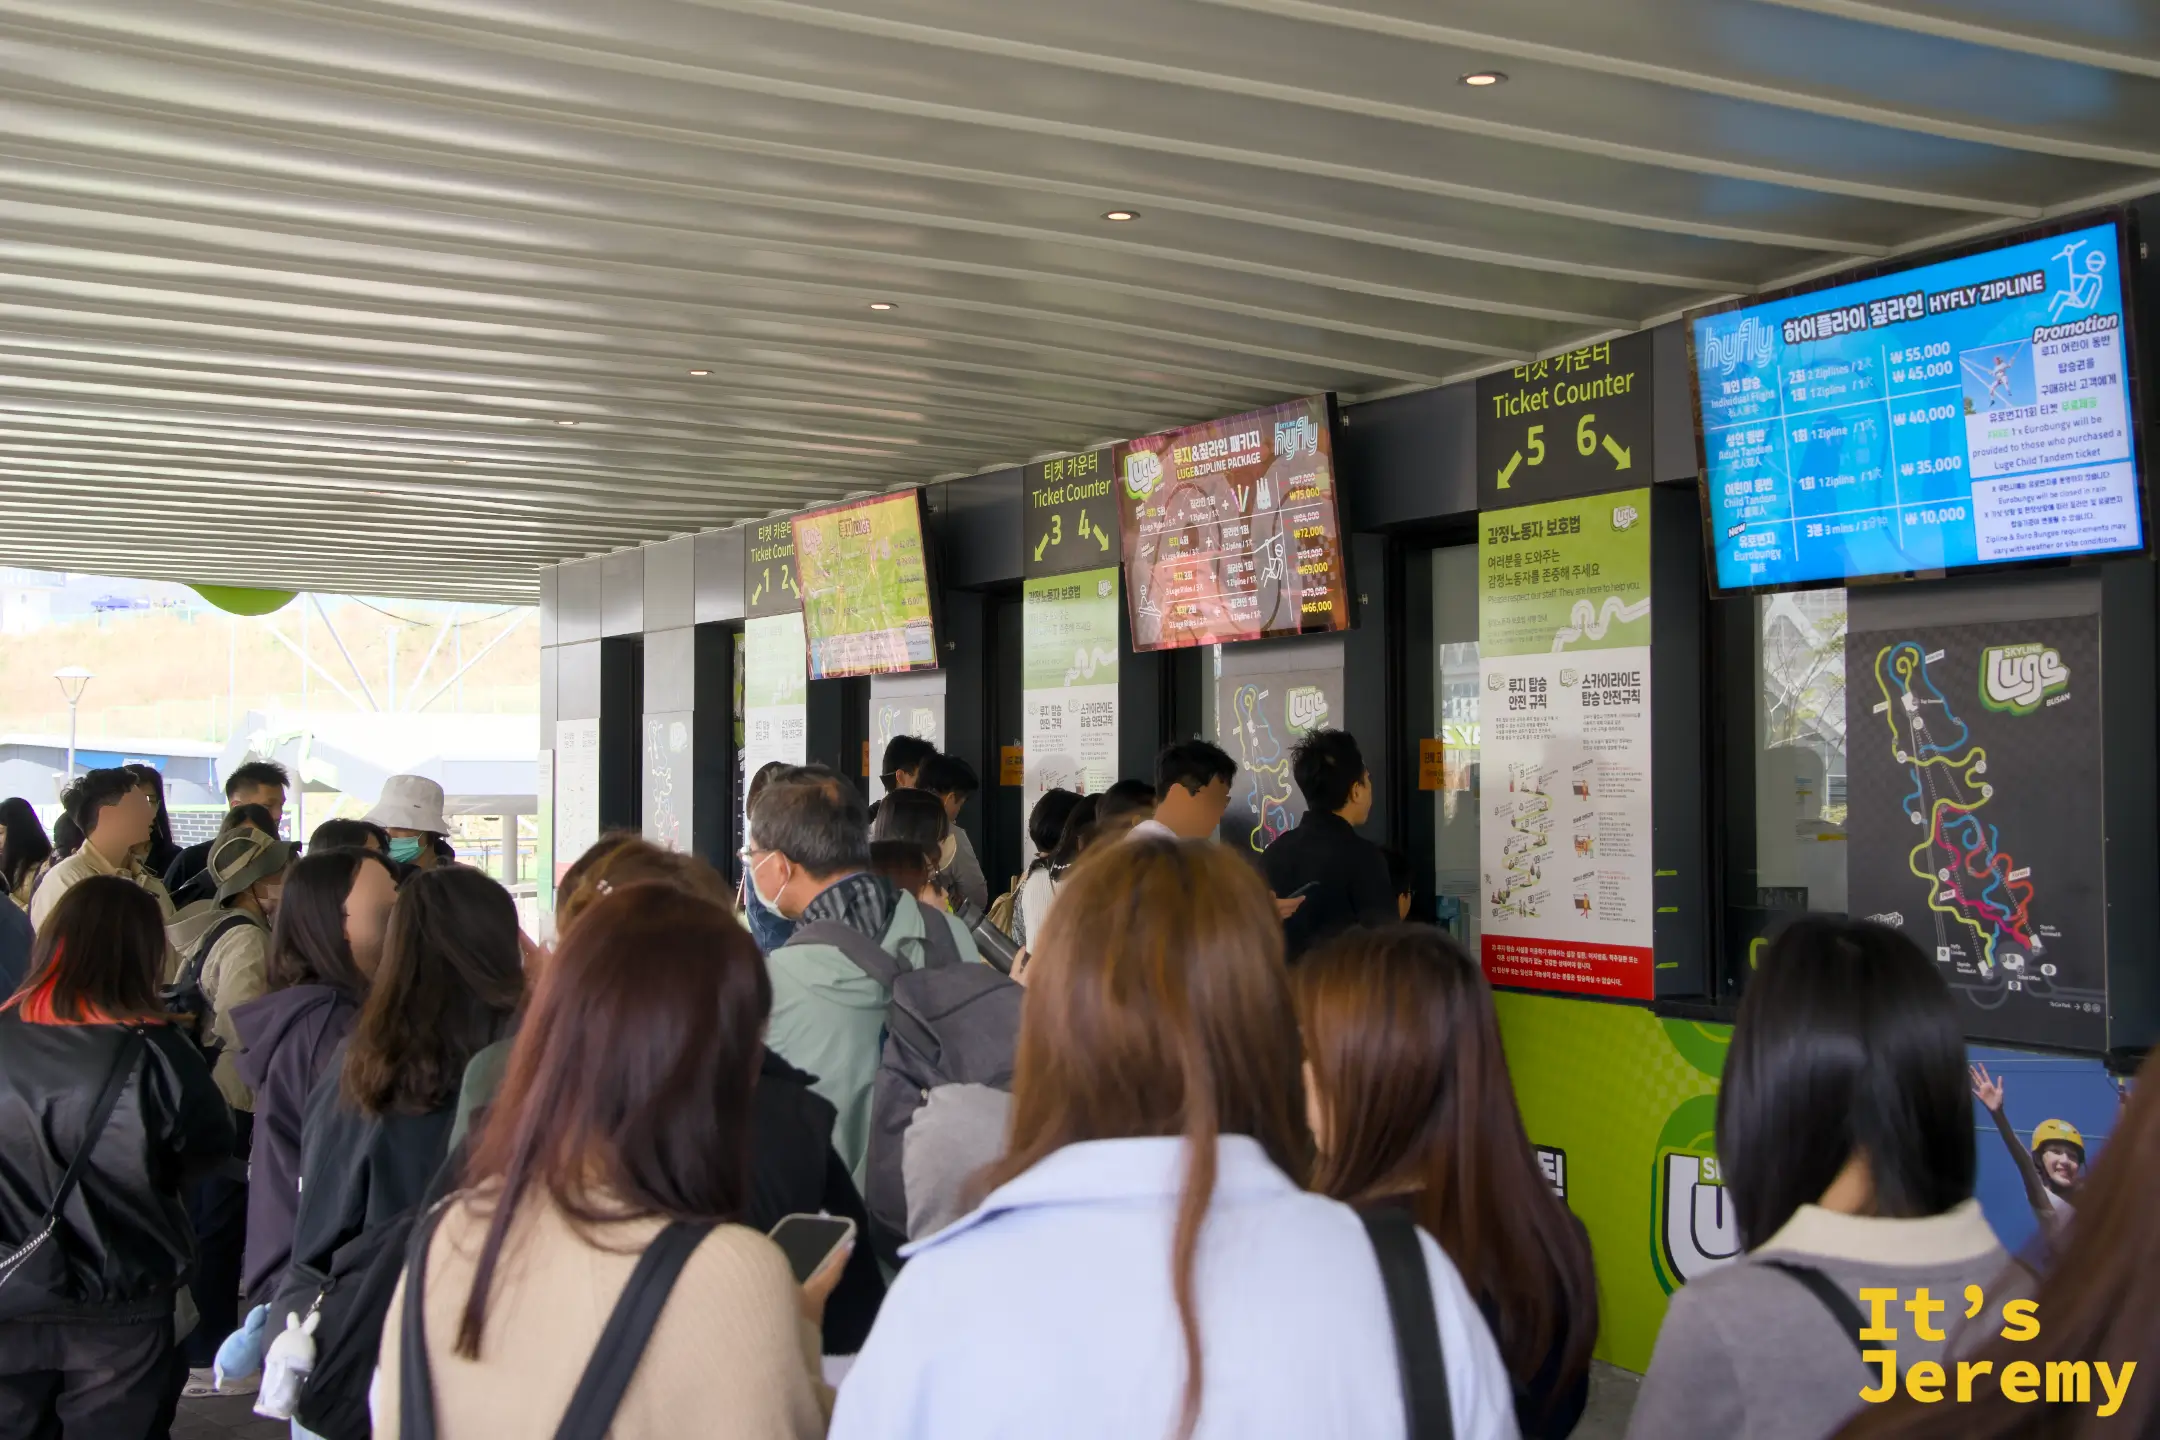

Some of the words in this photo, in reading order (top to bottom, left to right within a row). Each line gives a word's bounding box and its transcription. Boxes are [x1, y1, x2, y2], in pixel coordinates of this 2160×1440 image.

[1782, 305, 1867, 343] 하이플라이
[1928, 287, 1978, 313] HYFLY
[1979, 272, 2044, 302] ZIPLINE
[2032, 313, 2119, 344] Promotion
[1703, 316, 1774, 376] hyfly
[1904, 341, 1951, 363] 55,000
[2061, 339, 2090, 354] 어린이
[2092, 335, 2111, 349] 동반
[1815, 364, 1849, 381] Ziplines
[1907, 360, 1953, 382] 45,000
[2057, 357, 2096, 375] 탑승권을
[1816, 384, 1847, 400] Zipline
[2041, 380, 2077, 397] 구매하신
[2079, 373, 2117, 390] 고객에게
[1493, 387, 1549, 419] Ticket
[1553, 372, 1635, 407] Counter
[1908, 404, 1956, 424] 40,000
[1817, 426, 1848, 441] Zipline
[2024, 419, 2071, 435] Eurobungy
[2073, 415, 2089, 426] will
[2090, 414, 2102, 425] be
[1229, 430, 1261, 452] 패키지
[1274, 415, 1318, 461] hyfly
[1527, 424, 1545, 466] 5
[1576, 413, 1597, 456] 6
[1972, 444, 2009, 459] provided
[2010, 443, 2019, 452] to
[2021, 438, 2045, 451] those
[2047, 436, 2066, 447] who
[2067, 430, 2114, 447] purchased
[1718, 448, 1741, 460] Adult
[1741, 444, 1773, 458] Tandem
[1994, 458, 2015, 472] Luge
[2016, 455, 2037, 467] Child
[2038, 450, 2074, 465] Tandem
[2075, 447, 2101, 460] ticket
[1043, 458, 1064, 482] 티켓
[1067, 450, 1098, 477] 카운터
[1126, 452, 1162, 494] Luge
[1176, 459, 1227, 481] LUGE&ZIPLINE
[1227, 451, 1262, 470] PACKAGE
[1916, 455, 1962, 475] 35,000
[1825, 474, 1856, 489] Zipline
[1032, 486, 1065, 508] Ticket
[1066, 479, 1111, 502] Counter
[1289, 486, 1320, 501] ₩75,000
[1723, 496, 1745, 508] Child
[1745, 493, 1777, 506] Tandem
[1998, 493, 2035, 506] Eurobungy
[2036, 490, 2048, 500] will
[2049, 489, 2058, 499] be
[2059, 487, 2082, 498] closed
[1920, 506, 1966, 525] 10,000
[758, 523, 772, 543] 티켓
[1051, 514, 1061, 546] 3
[1078, 508, 1091, 540] 4
[1293, 525, 1324, 539] ₩72,000
[1487, 519, 1544, 546] 감정노동자
[1546, 514, 1581, 537] 보호법
[1728, 522, 1747, 539] New
[1825, 525, 1831, 535] 3
[1832, 521, 1854, 534] mins
[750, 545, 772, 563] Ticket
[1487, 552, 1523, 570] 여러분을
[1524, 548, 1561, 566] 도와주는
[1733, 547, 1782, 562] Eurobungy
[763, 567, 770, 593] 1
[781, 564, 789, 590] 2
[1487, 568, 1540, 590] 감정노동자를
[1541, 565, 1570, 583] 존중해
[1571, 562, 1601, 578] 주세요
[1507, 591, 1530, 603] respect
[1531, 590, 1541, 600] our
[1558, 586, 1574, 599] They
[1586, 584, 1602, 595] here
[1602, 583, 1610, 593] to
[1610, 582, 1626, 594] help
[1301, 600, 1332, 613] ₩66,000
[2004, 645, 2042, 657] SKYLINE
[1508, 677, 1527, 693] 루지
[1528, 676, 1548, 693] 탑승
[1581, 670, 1641, 690] 스카이라이드
[1986, 649, 2068, 706] Luge
[1508, 695, 1527, 711] 안전
[1528, 694, 1548, 710] 규칙
[1581, 692, 1601, 707] 탑승
[1602, 688, 1641, 706] 안전규칙
[2045, 692, 2071, 707] BUSAN
[1288, 689, 1329, 730] Luge
